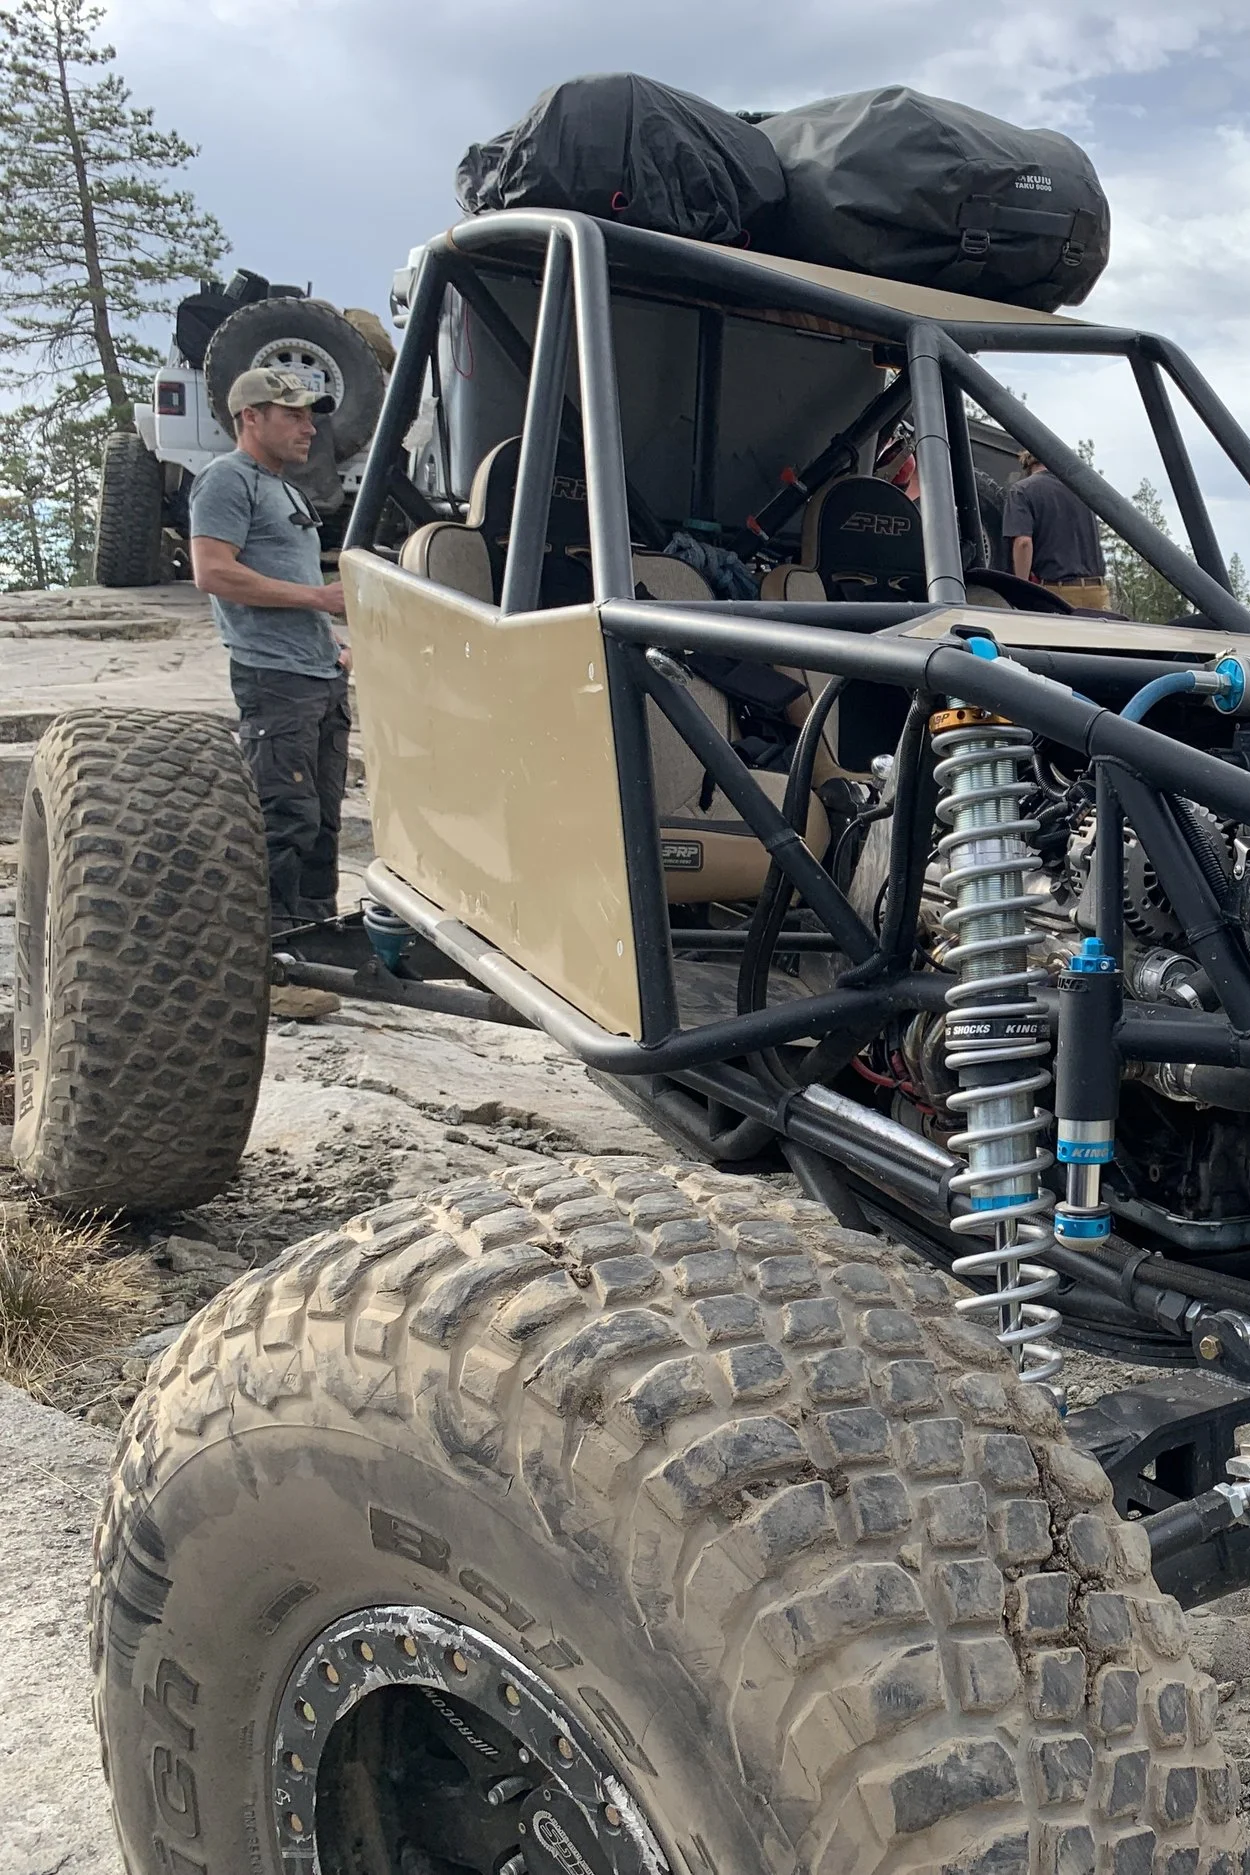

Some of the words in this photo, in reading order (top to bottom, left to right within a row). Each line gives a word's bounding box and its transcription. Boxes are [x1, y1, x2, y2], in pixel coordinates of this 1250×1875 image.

[1014, 182, 1035, 190] TAKU
[840, 511, 911, 536] PRP
[953, 1023, 992, 1036] SHOCKS
[1005, 1023, 1038, 1035] KING
[420, 1687, 486, 1746] PROCOM
